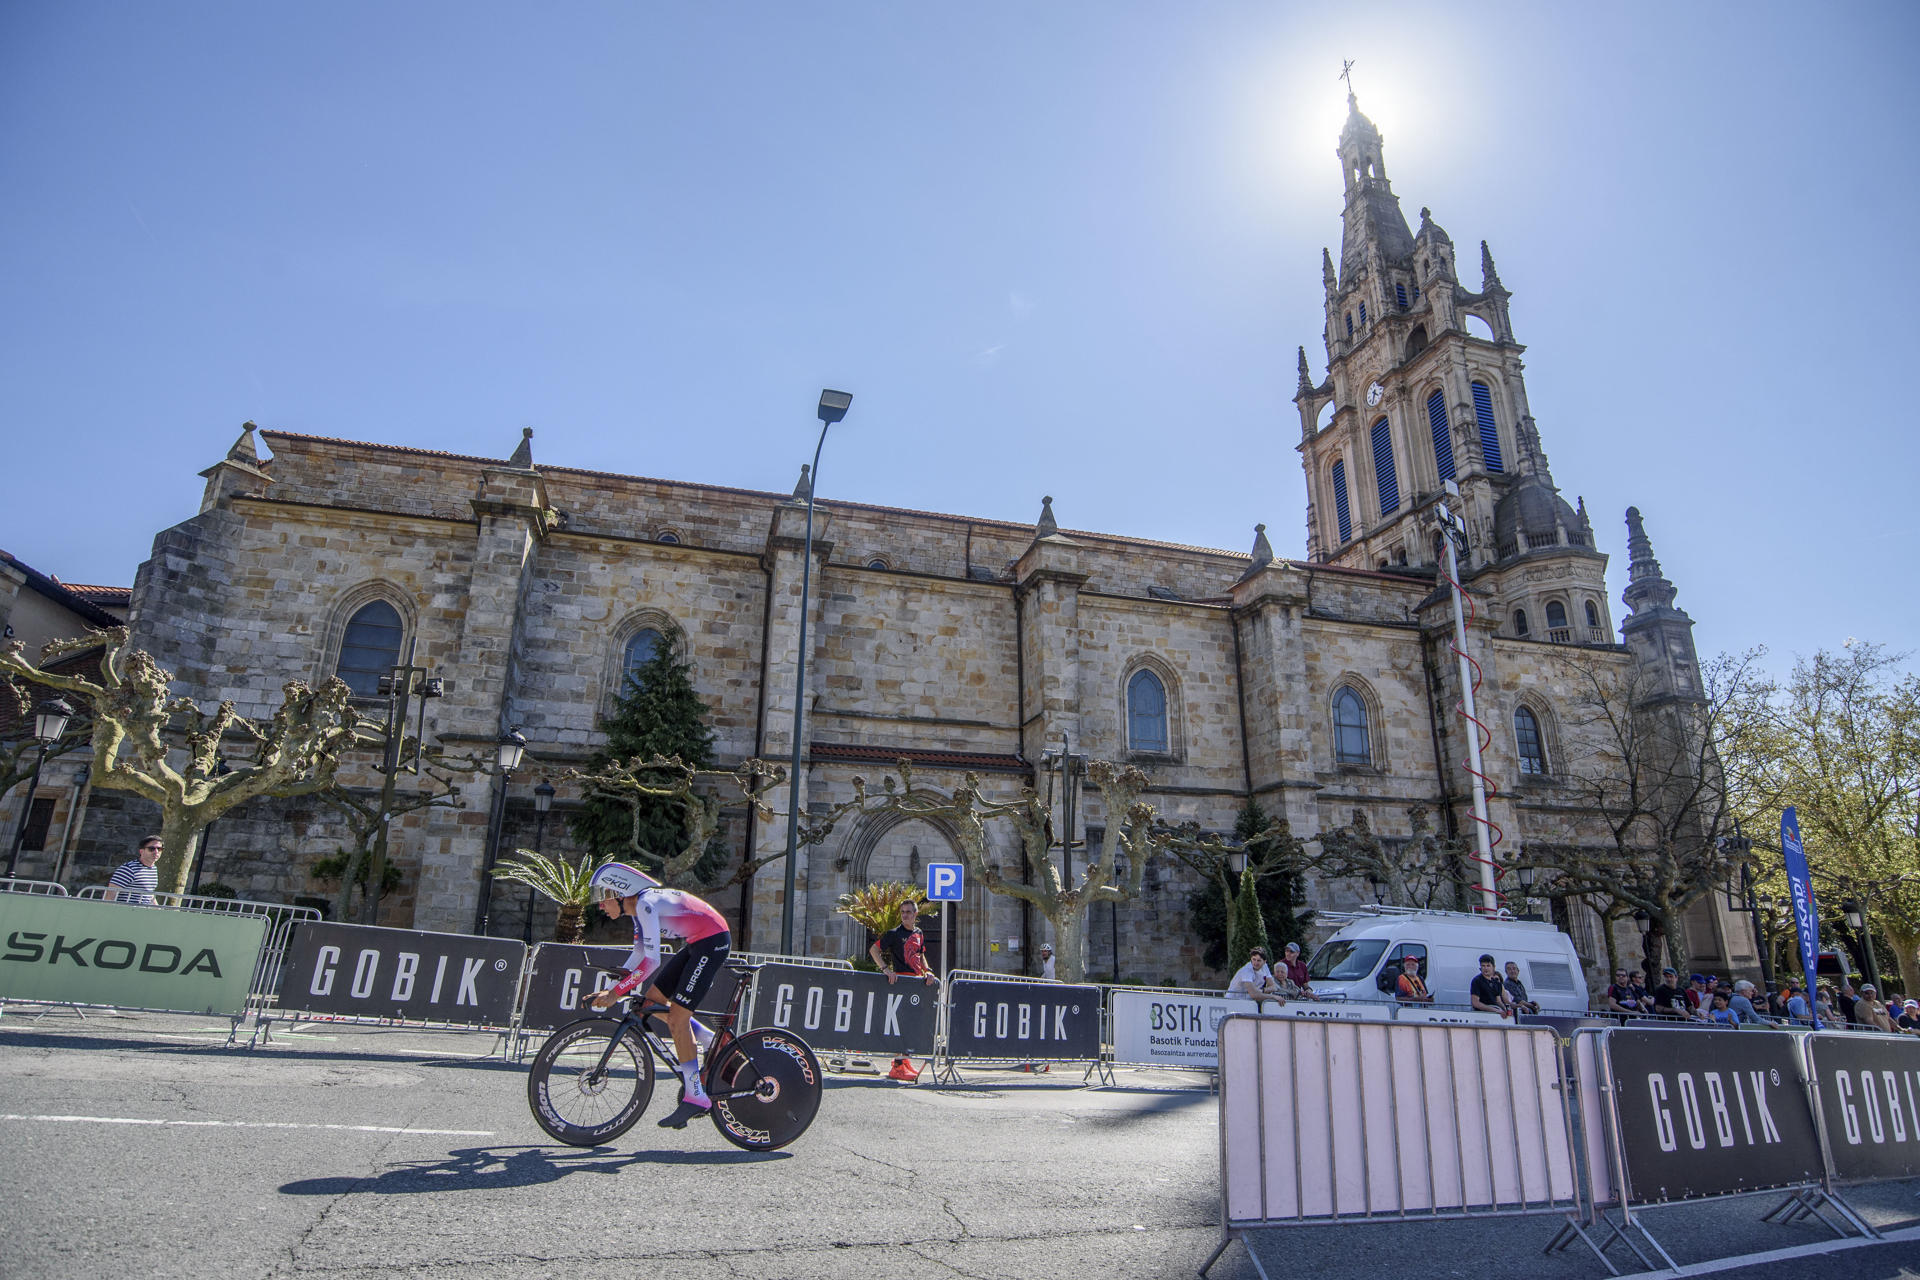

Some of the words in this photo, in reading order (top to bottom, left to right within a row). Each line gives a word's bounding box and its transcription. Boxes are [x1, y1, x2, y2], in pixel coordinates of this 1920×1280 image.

[934, 867, 957, 896] P
[309, 945, 486, 1006] GOBIK
[686, 955, 709, 993] SIROKO
[773, 983, 903, 1037] GOBIK
[973, 1001, 1068, 1041] GOBIK
[1150, 1002, 1201, 1033] BSTK
[1150, 1035, 1182, 1046] Basotik
[1184, 1036, 1218, 1048] Fundazi
[1150, 1048, 1186, 1058] Basozaintza
[1647, 1071, 1782, 1152] GOBIK
[1835, 1069, 1920, 1145] GOBI
